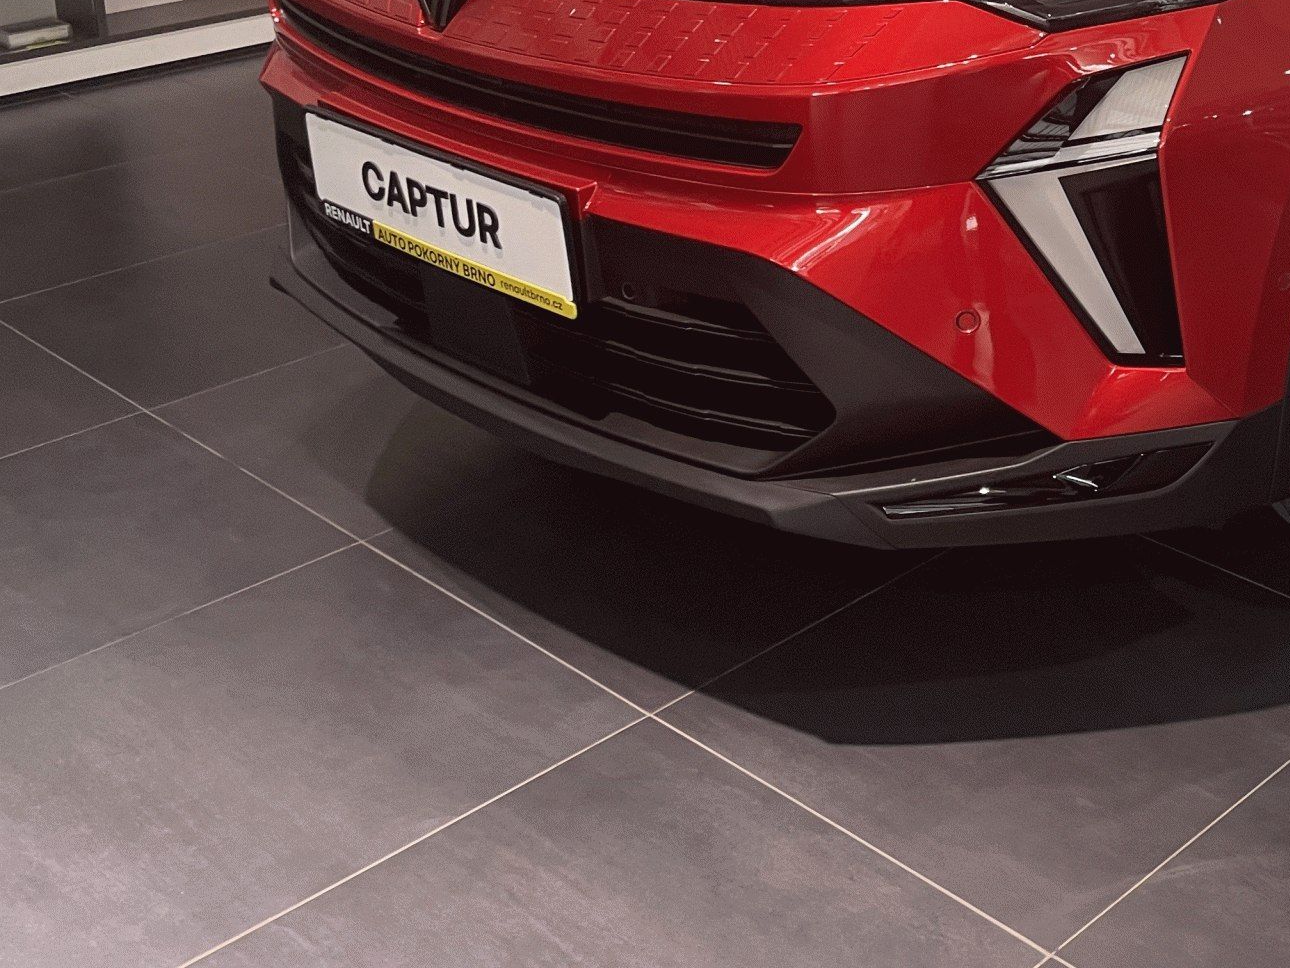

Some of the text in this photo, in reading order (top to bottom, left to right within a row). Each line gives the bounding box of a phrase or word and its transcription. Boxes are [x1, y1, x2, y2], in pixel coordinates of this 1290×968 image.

[361, 160, 502, 250] CAPTUR
[324, 202, 563, 311] RENAULT AUTO POKORNÝ BRNO renaultbrno.cz
